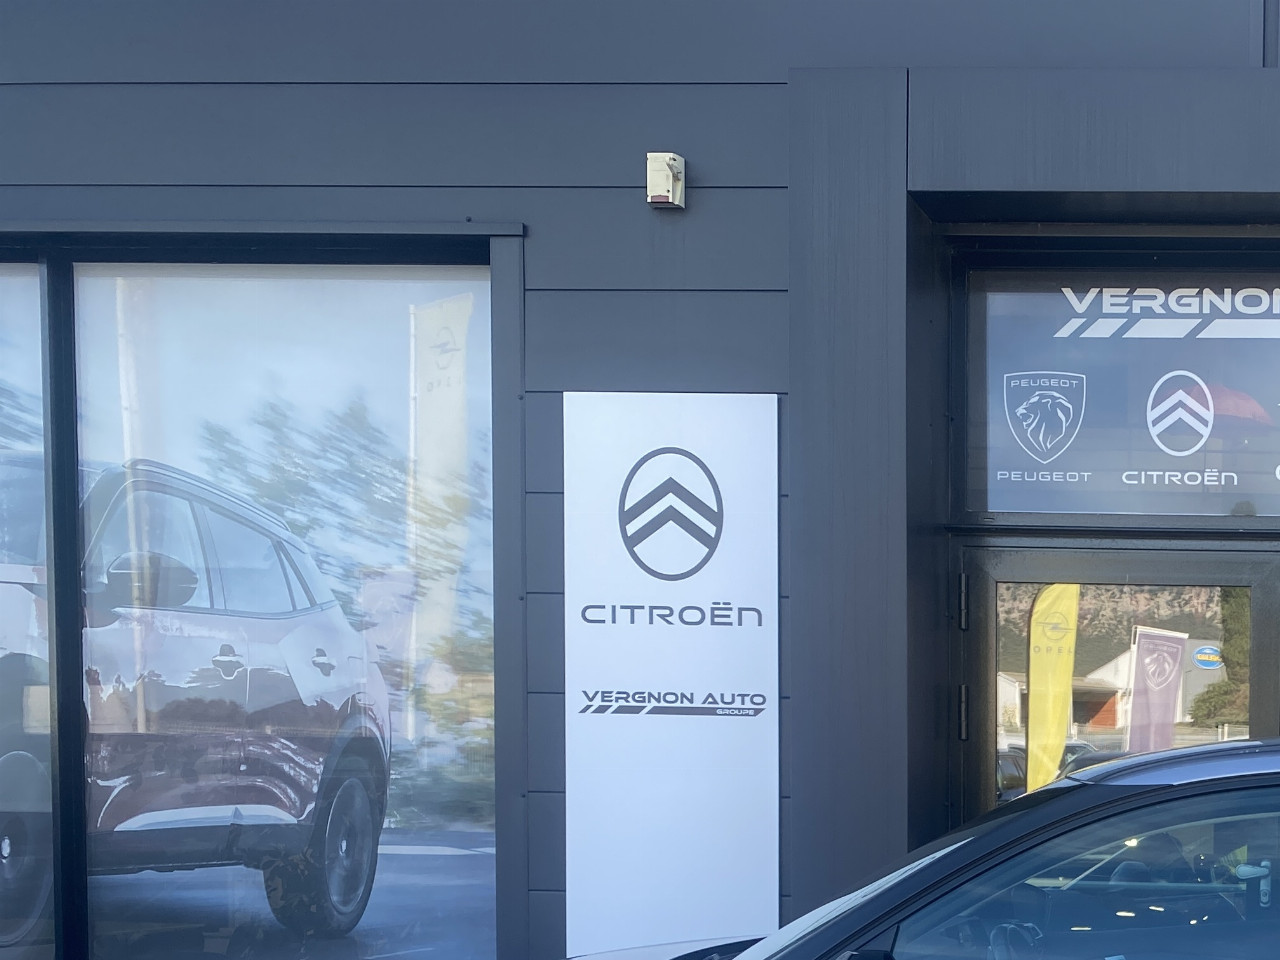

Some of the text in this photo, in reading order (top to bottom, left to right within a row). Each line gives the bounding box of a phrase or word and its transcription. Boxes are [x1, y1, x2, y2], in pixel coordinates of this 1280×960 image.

[1010, 378, 1079, 388] PEUGEOT
[996, 470, 1093, 482] PEUGEOT
[581, 689, 767, 706] VERGNON AUTO
[715, 708, 755, 716] GROUPE
